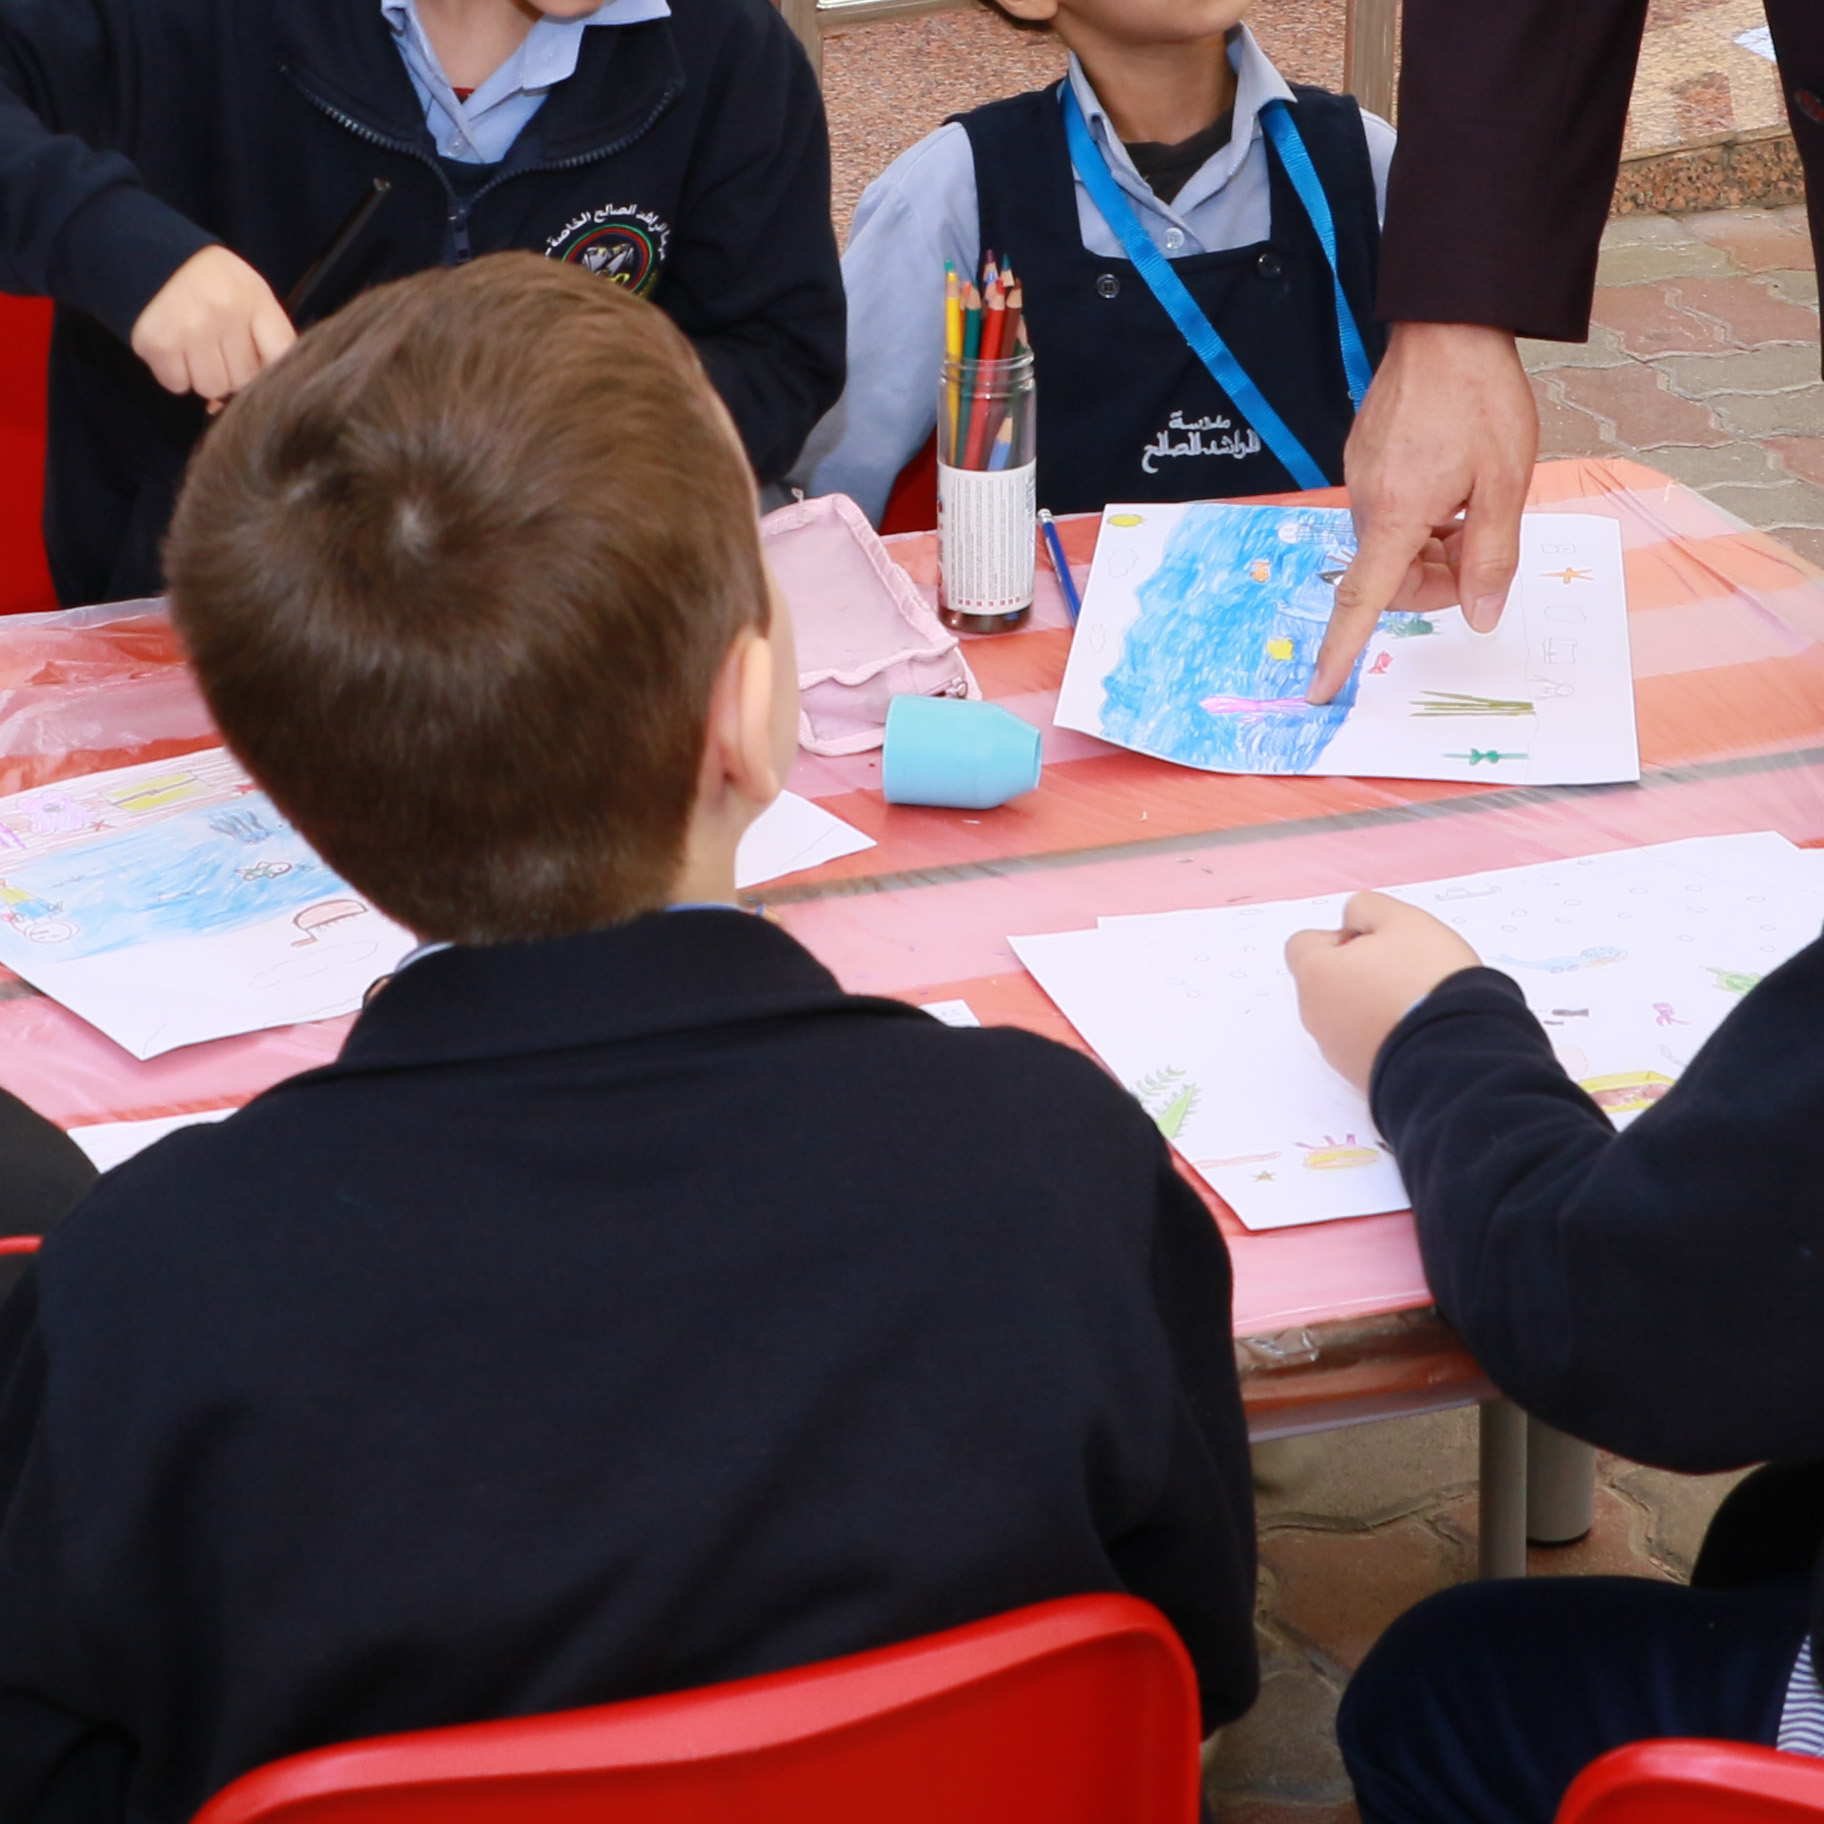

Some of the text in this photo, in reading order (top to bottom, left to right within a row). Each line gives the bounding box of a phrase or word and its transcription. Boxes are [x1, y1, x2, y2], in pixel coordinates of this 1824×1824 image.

[593, 203, 638, 223] الصالح
[546, 211, 591, 247] الخاصة
[1168, 409, 1232, 430] مدرسة
[1141, 428, 1262, 474] الراشد الصالح
